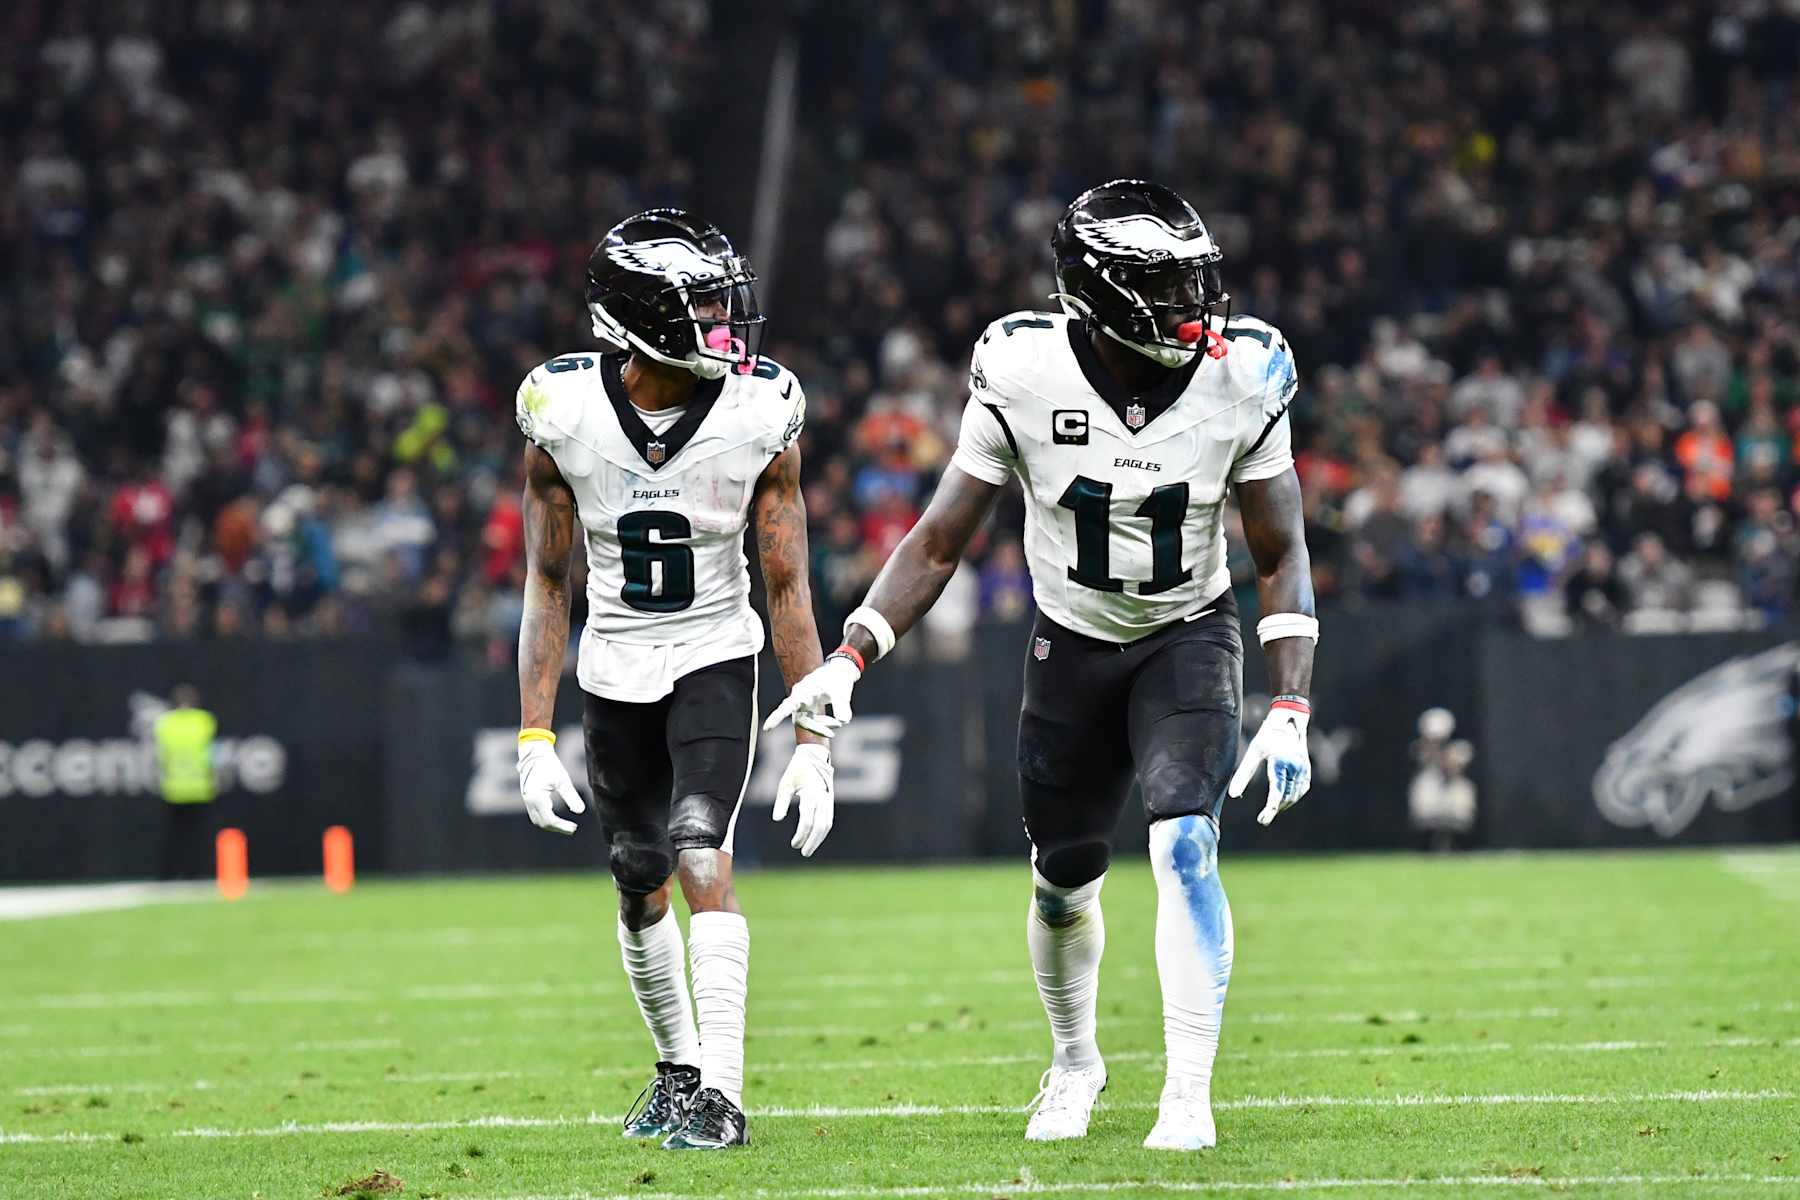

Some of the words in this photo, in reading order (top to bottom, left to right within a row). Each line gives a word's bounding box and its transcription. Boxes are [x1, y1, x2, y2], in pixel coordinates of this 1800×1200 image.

[545, 357, 593, 373] 6
[1055, 412, 1086, 435] C
[1114, 458, 1162, 472] EAGLES
[633, 489, 680, 499] EAGLES
[1057, 474, 1192, 595] 11
[617, 510, 695, 613] 6
